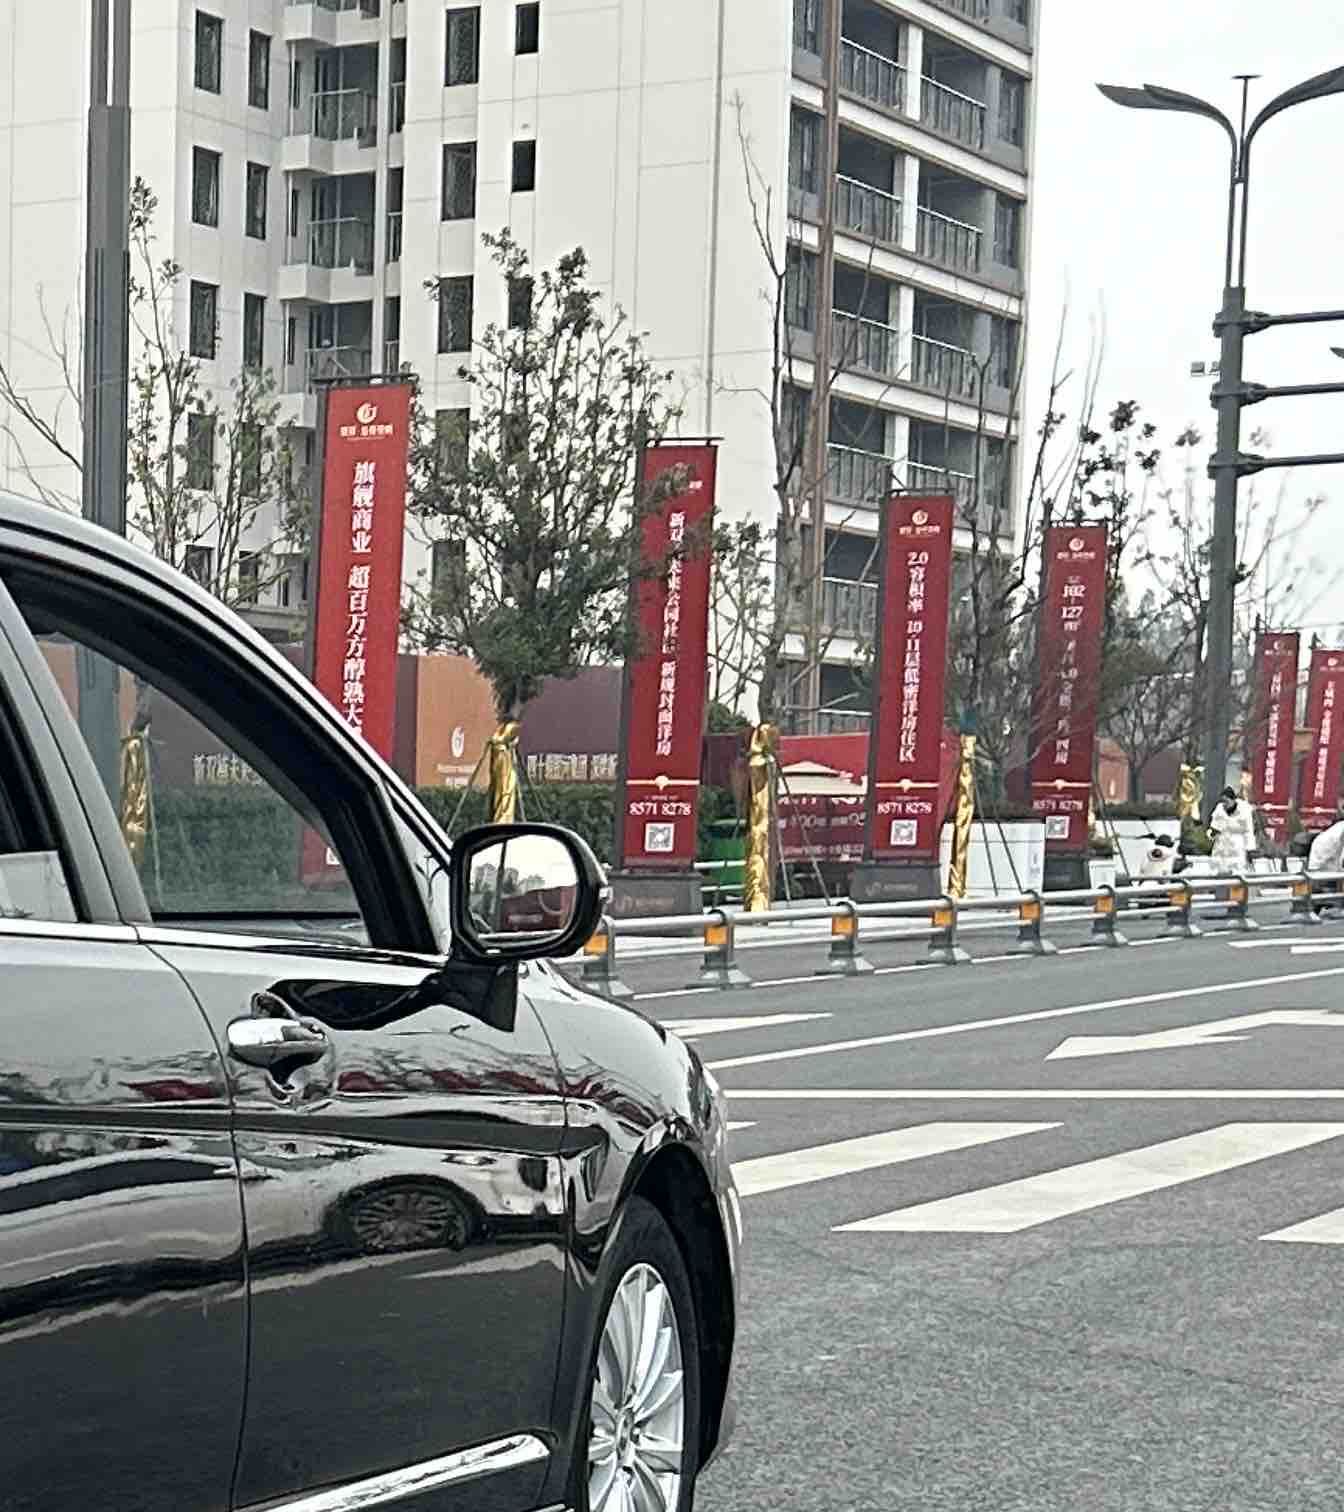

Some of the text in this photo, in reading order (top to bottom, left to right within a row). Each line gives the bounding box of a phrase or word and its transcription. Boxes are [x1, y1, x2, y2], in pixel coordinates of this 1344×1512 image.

[350, 461, 376, 553] 旗舰商业
[342, 565, 371, 738] 超百万方醇熟大
[629, 802, 658, 815] 8571
